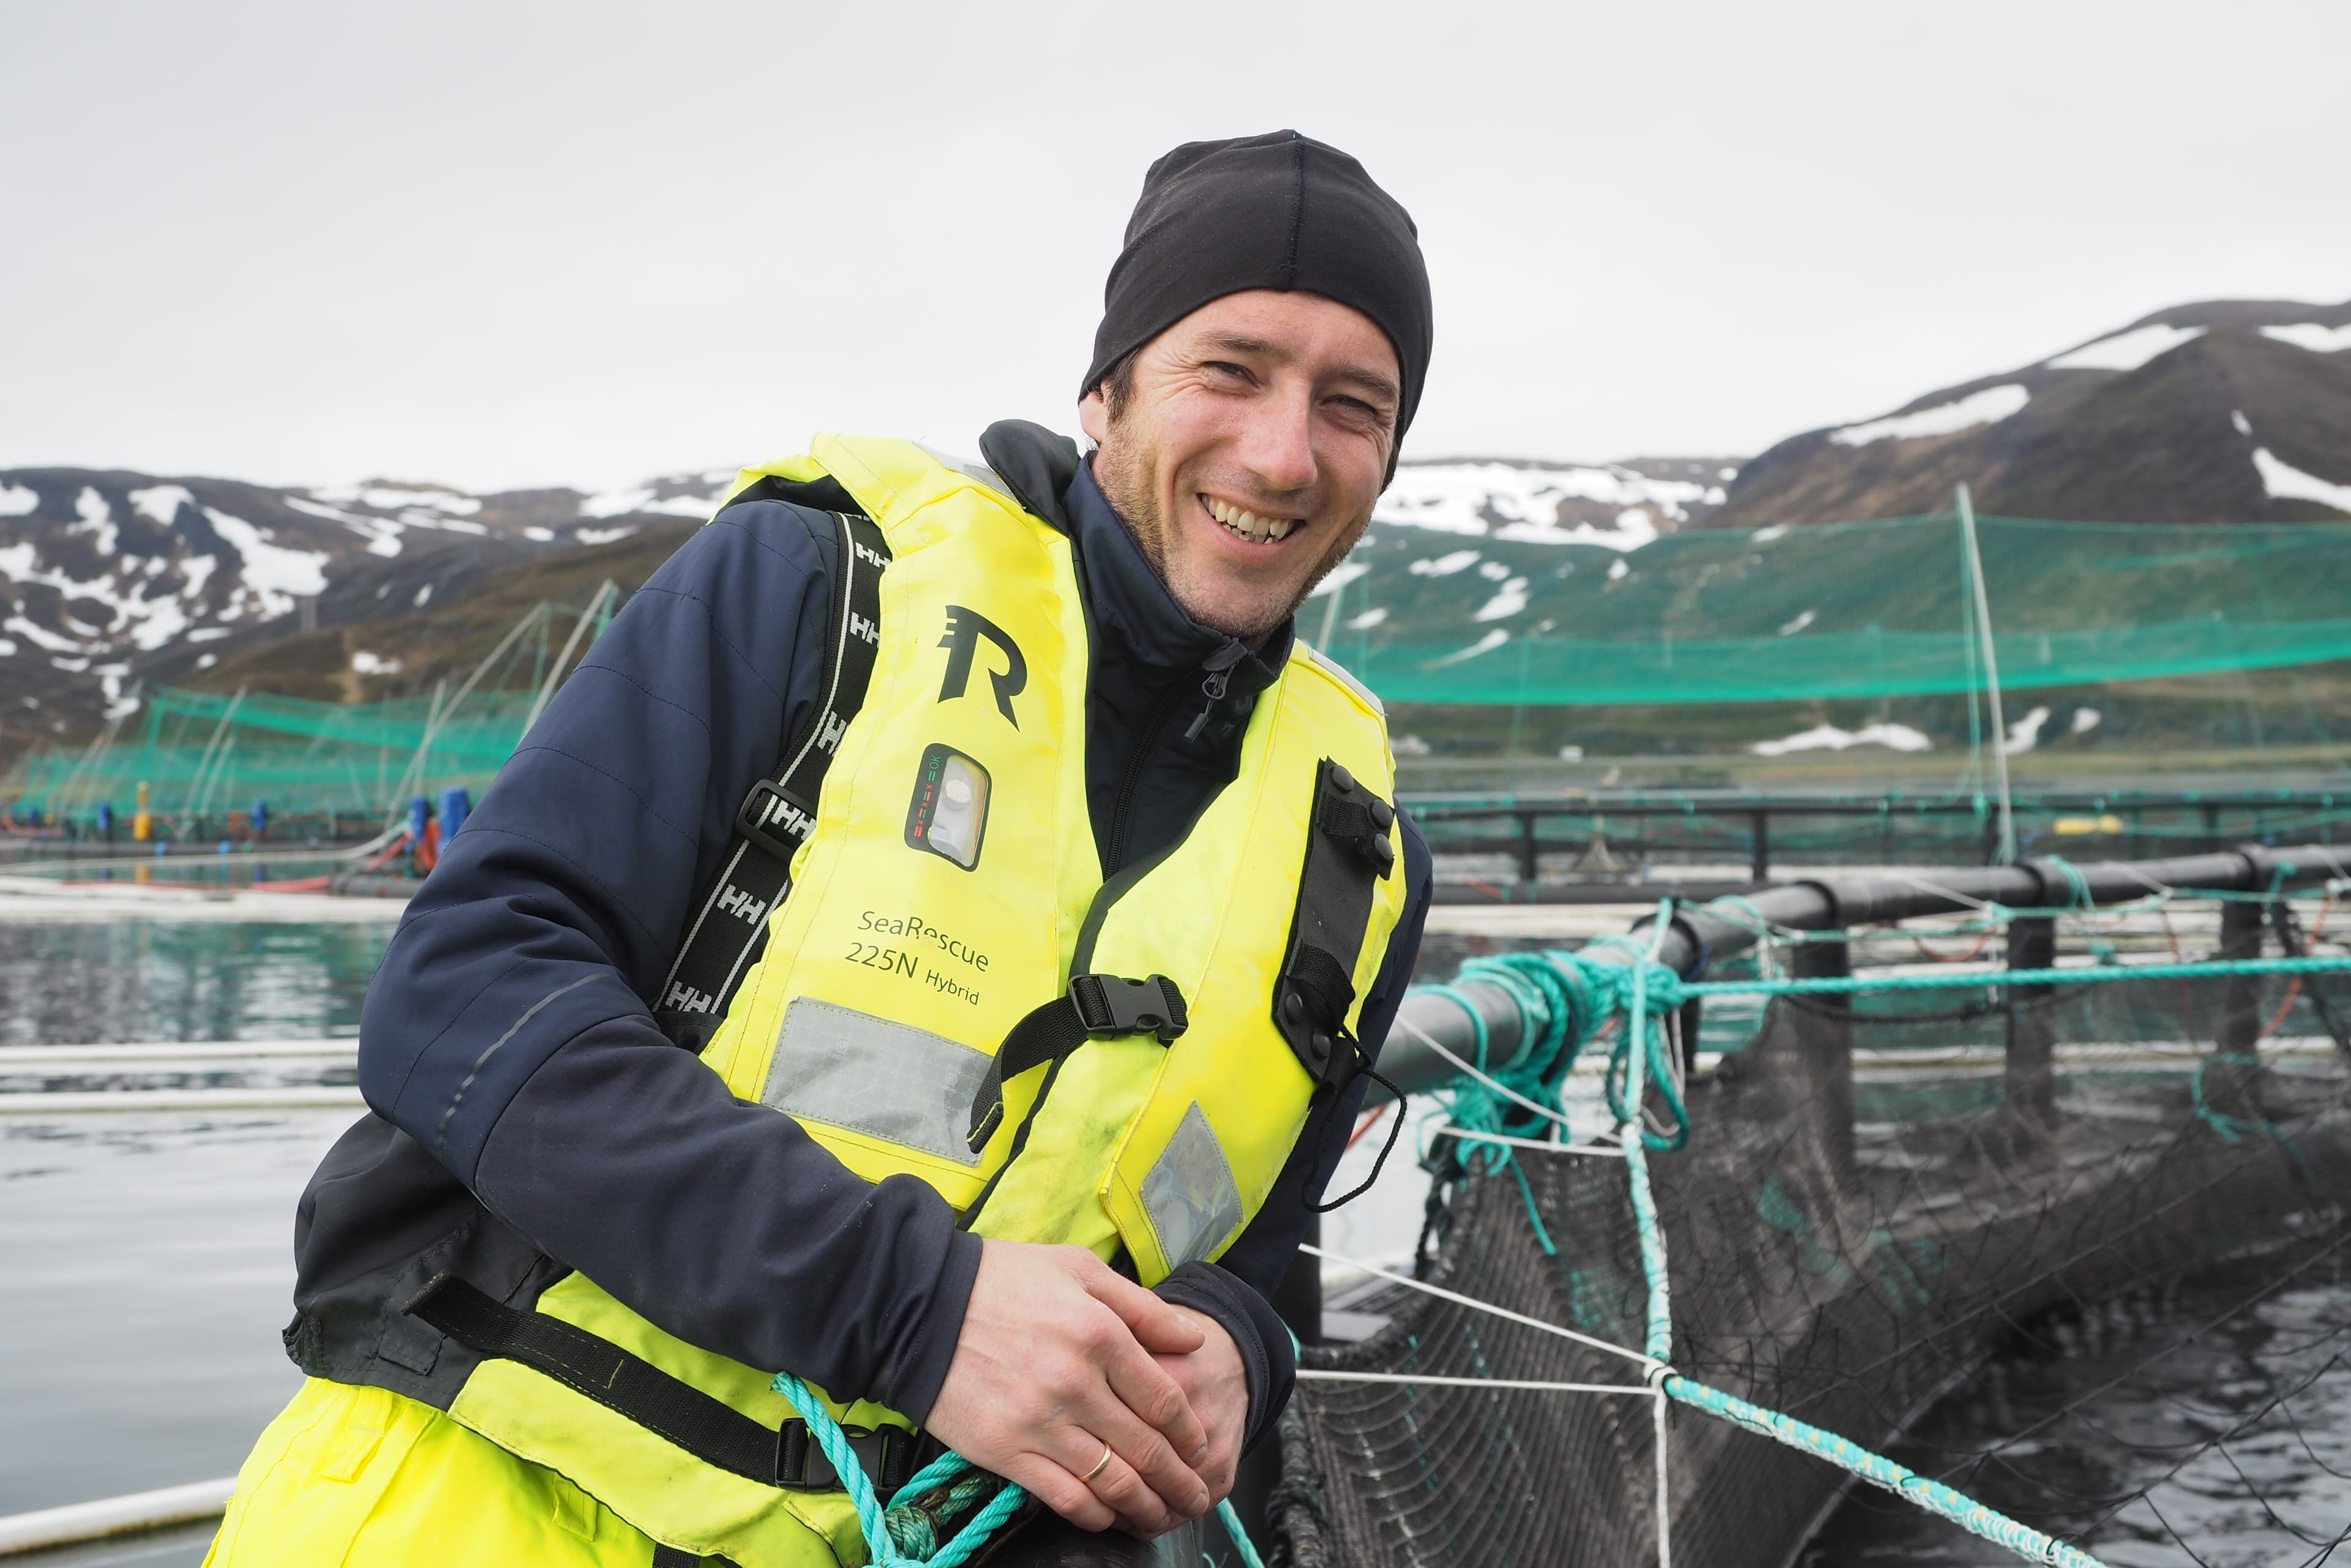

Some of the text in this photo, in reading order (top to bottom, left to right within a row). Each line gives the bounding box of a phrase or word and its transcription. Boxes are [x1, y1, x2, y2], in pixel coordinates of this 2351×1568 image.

[855, 542, 891, 568] HH
[817, 710, 850, 757] H
[929, 755, 940, 770] OK
[771, 800, 817, 841] HH
[717, 883, 767, 925] HH
[857, 910, 989, 972] SeaRescue
[844, 942, 980, 1005] 225N Hybrid
[665, 980, 713, 1013] HH
